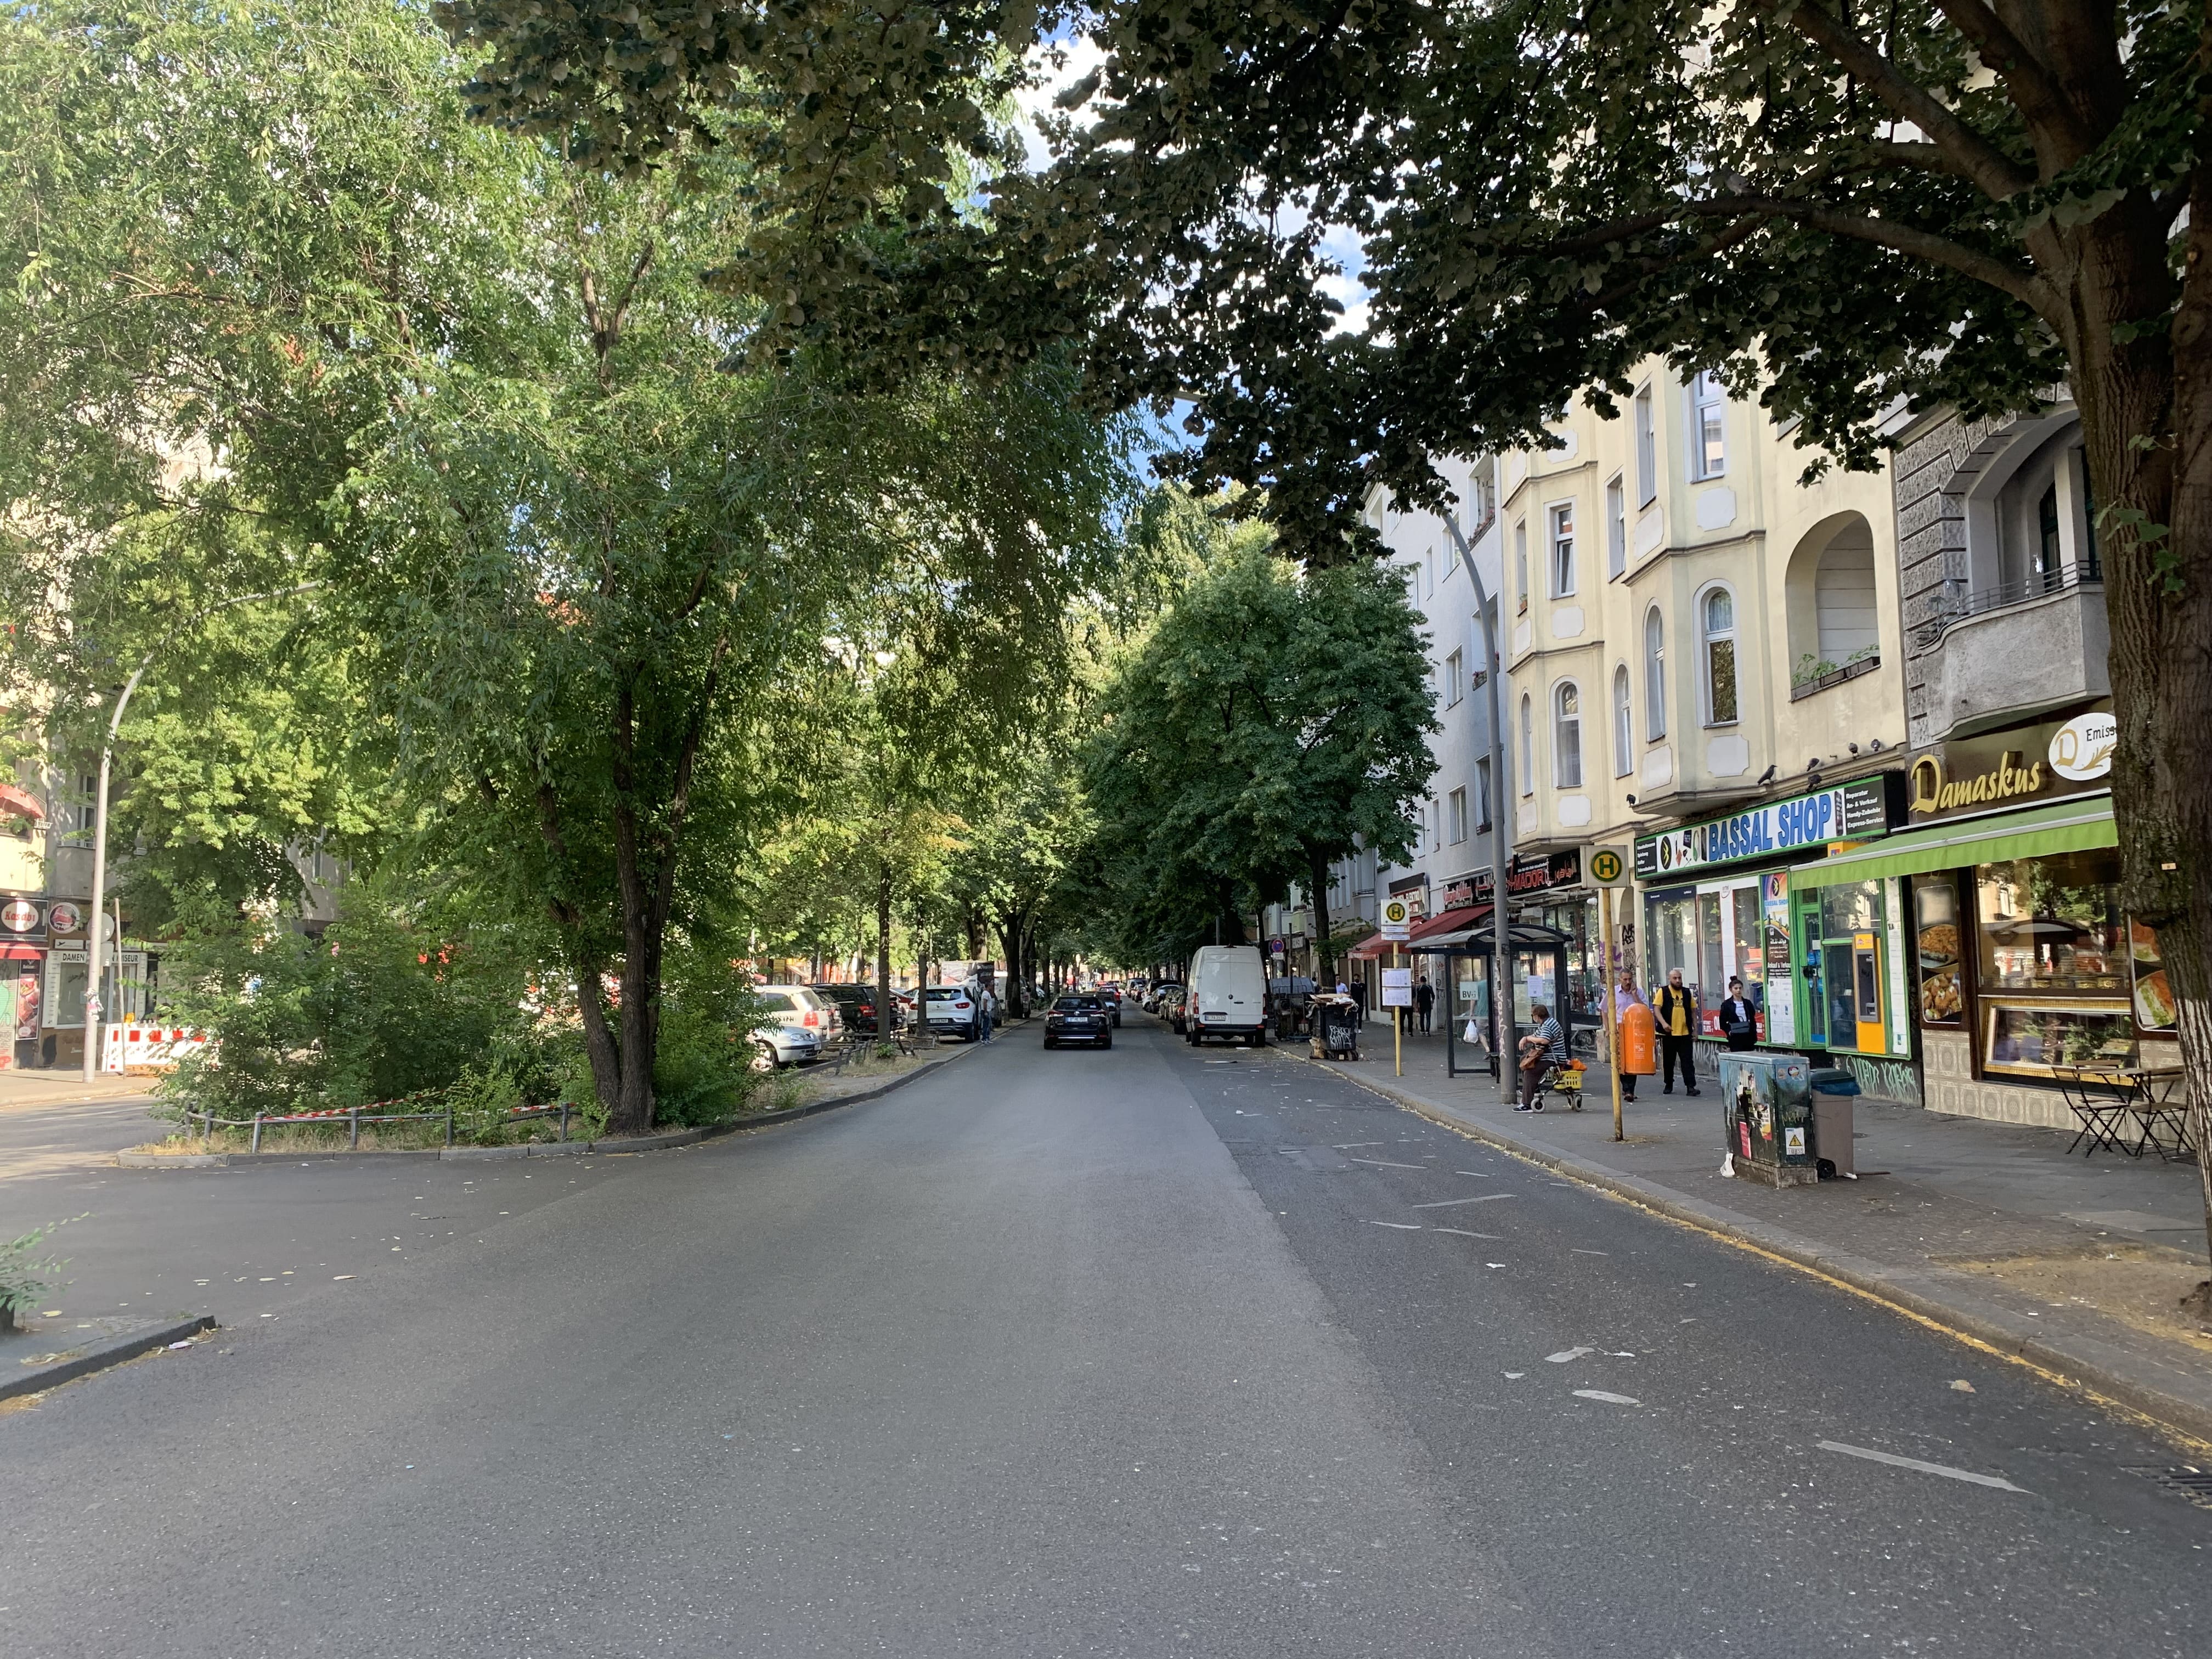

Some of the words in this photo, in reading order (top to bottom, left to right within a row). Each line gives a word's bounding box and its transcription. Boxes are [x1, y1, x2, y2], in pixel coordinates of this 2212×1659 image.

[1909, 751, 2040, 813] Damaskus
[1846, 789, 1869, 799] Reparatur
[1859, 797, 1878, 806] Verkauf
[1847, 806, 1881, 819] Handy-Zubehör
[1708, 810, 1773, 862] BASSAL
[1778, 793, 1832, 848] SHOP
[1847, 816, 1884, 828] Express-Service
[1599, 857, 1614, 875] H
[1391, 908, 1401, 917] H
